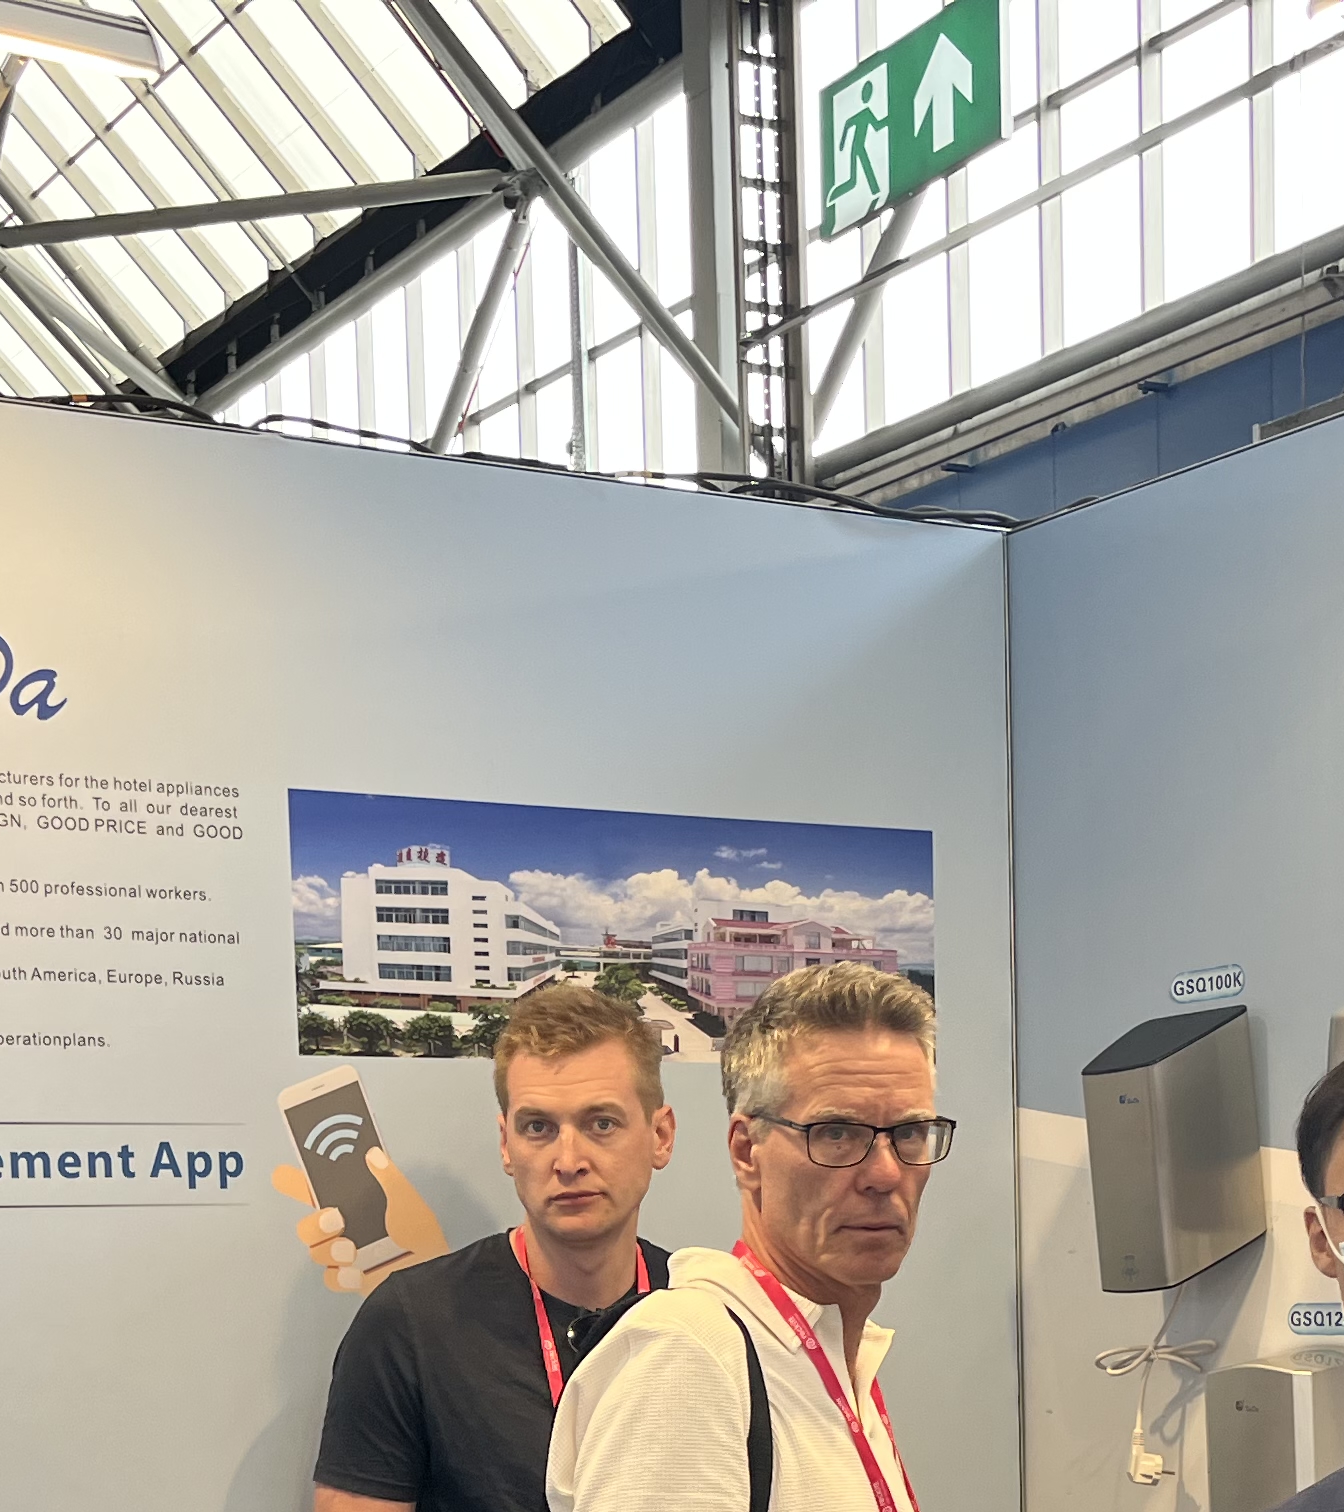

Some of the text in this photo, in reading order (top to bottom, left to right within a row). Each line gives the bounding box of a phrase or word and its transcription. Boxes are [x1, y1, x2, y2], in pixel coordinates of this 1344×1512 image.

[58, 772, 80, 788] for
[84, 775, 109, 790] the
[113, 776, 152, 792] hotel
[156, 781, 239, 798] appliances
[9, 878, 39, 894] 500
[44, 881, 142, 898] professional
[145, 885, 212, 902] workers.
[1172, 969, 1244, 999] GSQ100K
[149, 1139, 245, 1192] App
[1290, 1310, 1343, 1327] GSQ12
